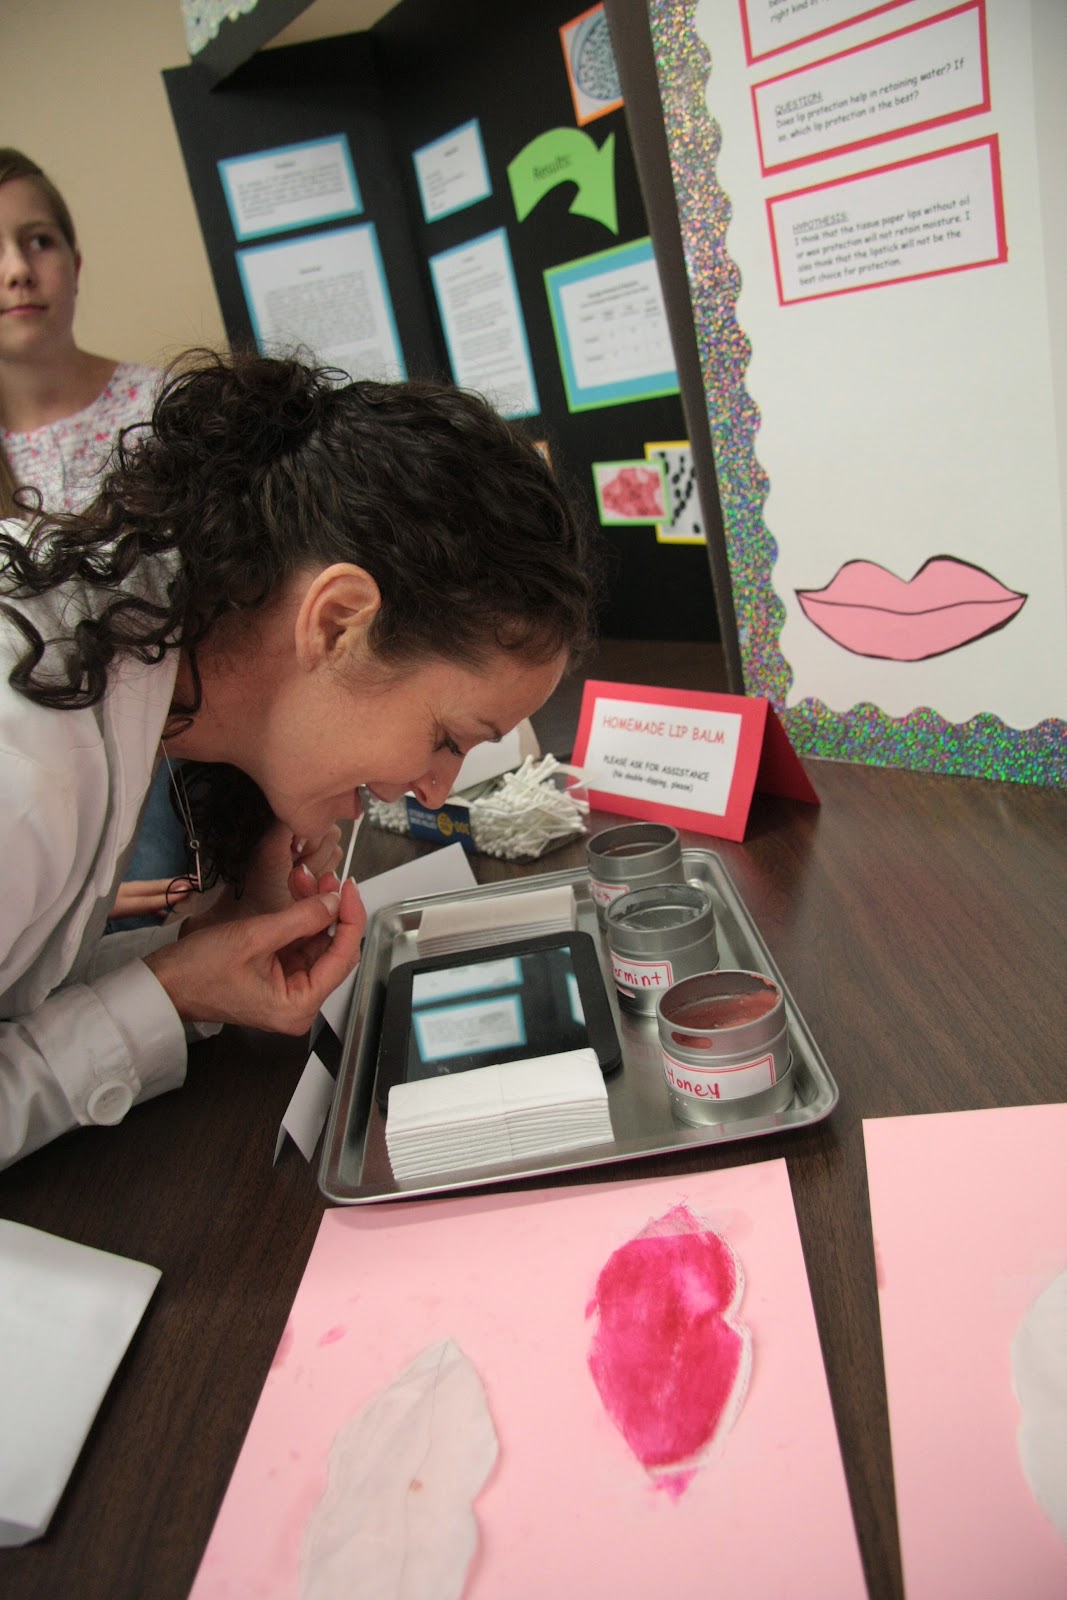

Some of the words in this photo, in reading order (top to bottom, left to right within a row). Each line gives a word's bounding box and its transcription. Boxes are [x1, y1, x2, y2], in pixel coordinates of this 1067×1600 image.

[770, 8, 790, 23] right
[776, 117, 794, 129] Does
[796, 112, 805, 123] lip
[807, 100, 848, 120] protection
[850, 92, 867, 105] help
[869, 89, 877, 98] in
[879, 77, 918, 94] retaining
[920, 62, 951, 81] water?
[954, 57, 964, 71] If
[790, 125, 811, 138] which
[813, 120, 822, 132] lip
[824, 108, 866, 130] protection
[868, 105, 875, 114] is
[878, 100, 892, 111] the
[894, 90, 919, 106] best?
[794, 237, 800, 246] I
[801, 233, 819, 243] think
[822, 228, 838, 239] that
[840, 225, 854, 235] the
[856, 219, 879, 231] tissue
[881, 212, 904, 226] paper
[907, 208, 921, 221] lips
[924, 199, 956, 215] without
[959, 195, 970, 207] oil
[796, 251, 804, 260] or
[806, 247, 820, 257] wax
[822, 239, 862, 255] protection
[864, 231, 877, 243] will
[879, 229, 892, 240] not
[895, 223, 921, 236] retain
[922, 215, 962, 230] moisture.
[965, 210, 971, 221] I
[798, 262, 812, 273] also
[814, 257, 833, 267] think
[835, 253, 851, 263] that
[853, 249, 867, 259] the
[869, 242, 898, 259] lipstick
[901, 238, 915, 250] will
[916, 235, 930, 246] not
[932, 233, 944, 244] be
[946, 229, 961, 241] the
[799, 274, 816, 286] best
[818, 270, 842, 281] choice
[844, 266, 856, 275] for
[602, 715, 666, 737] HOMEMADE
[668, 724, 688, 739] LIP
[692, 725, 725, 744] BALM
[603, 754, 628, 768] PLEASE
[629, 760, 643, 770] ASK
[645, 762, 659, 772] FOR
[661, 765, 711, 782] ASSISTANCE
[665, 1064, 720, 1099] Honey
